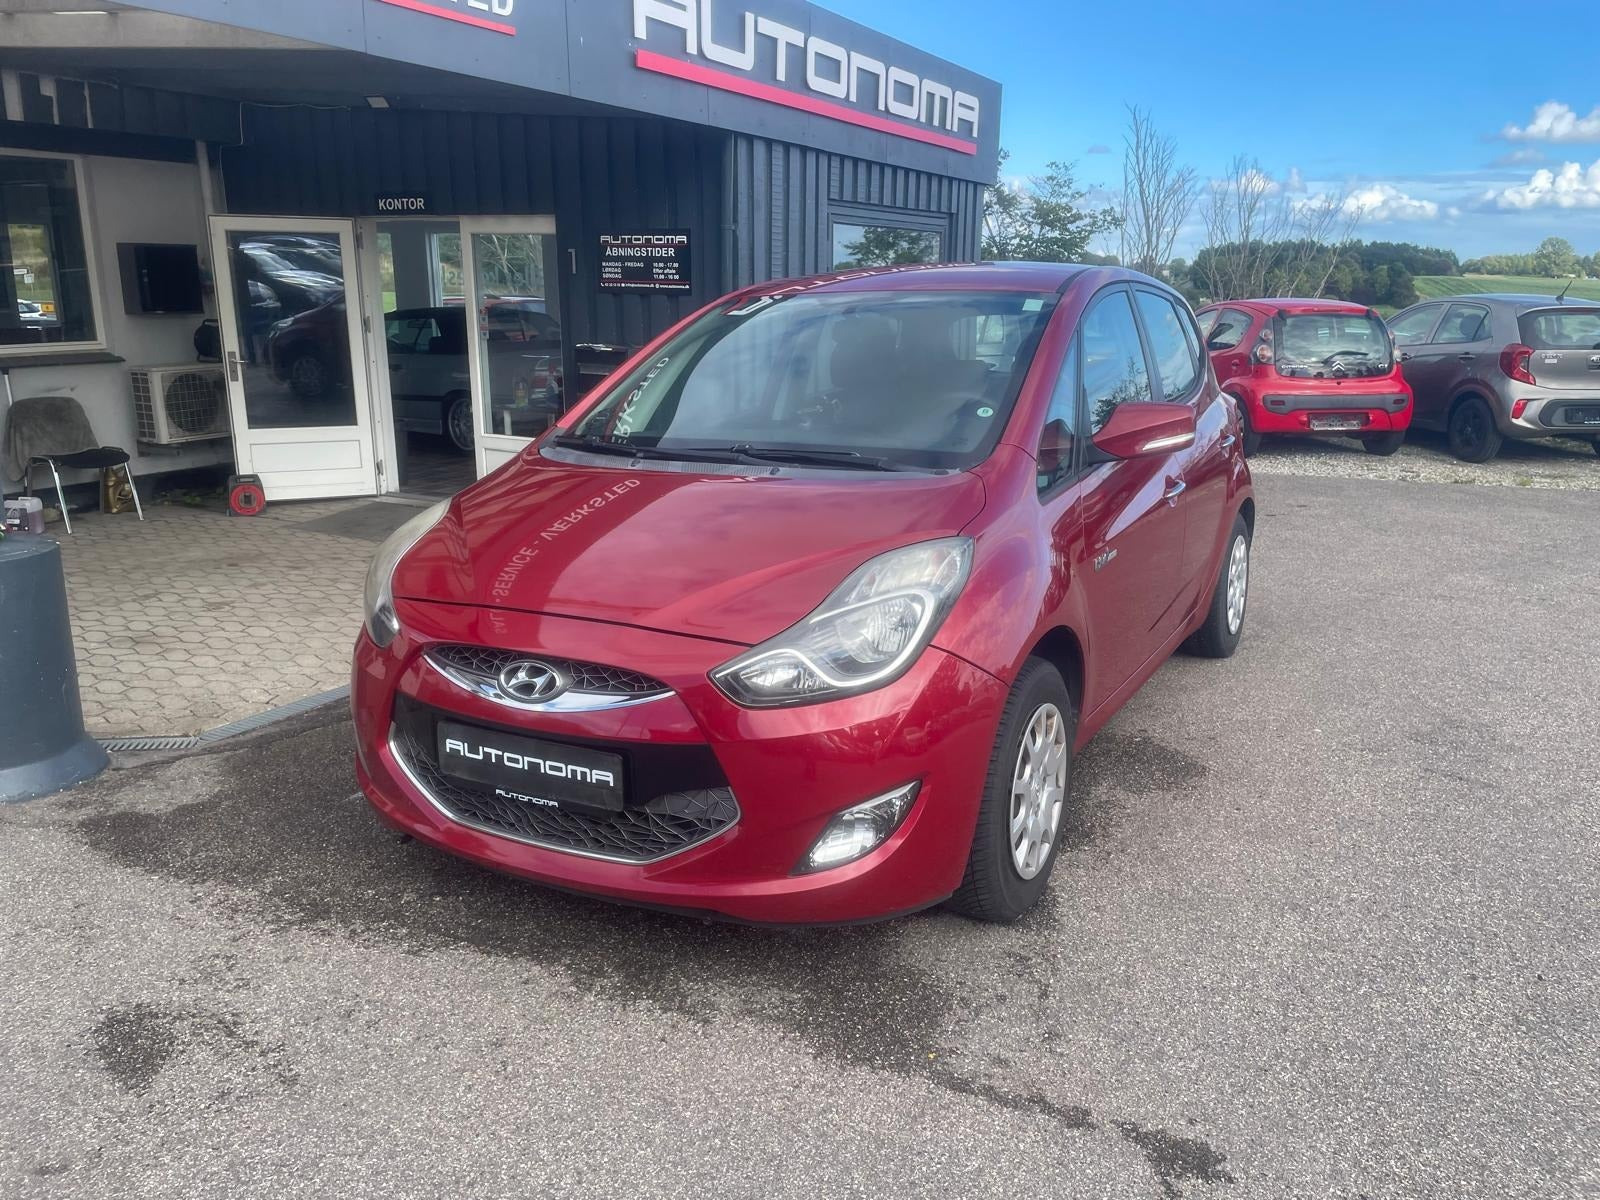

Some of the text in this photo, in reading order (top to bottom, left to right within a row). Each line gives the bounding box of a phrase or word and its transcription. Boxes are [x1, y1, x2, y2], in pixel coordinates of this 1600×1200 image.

[634, 0, 979, 138] AUTONOMA
[378, 198, 425, 211] KONTOR
[600, 235, 687, 244] AUTONOMA
[605, 246, 675, 257] ÅBNINGSTIDER
[445, 738, 614, 787] AUTONOMA
[495, 788, 559, 808] AUTONOMA
